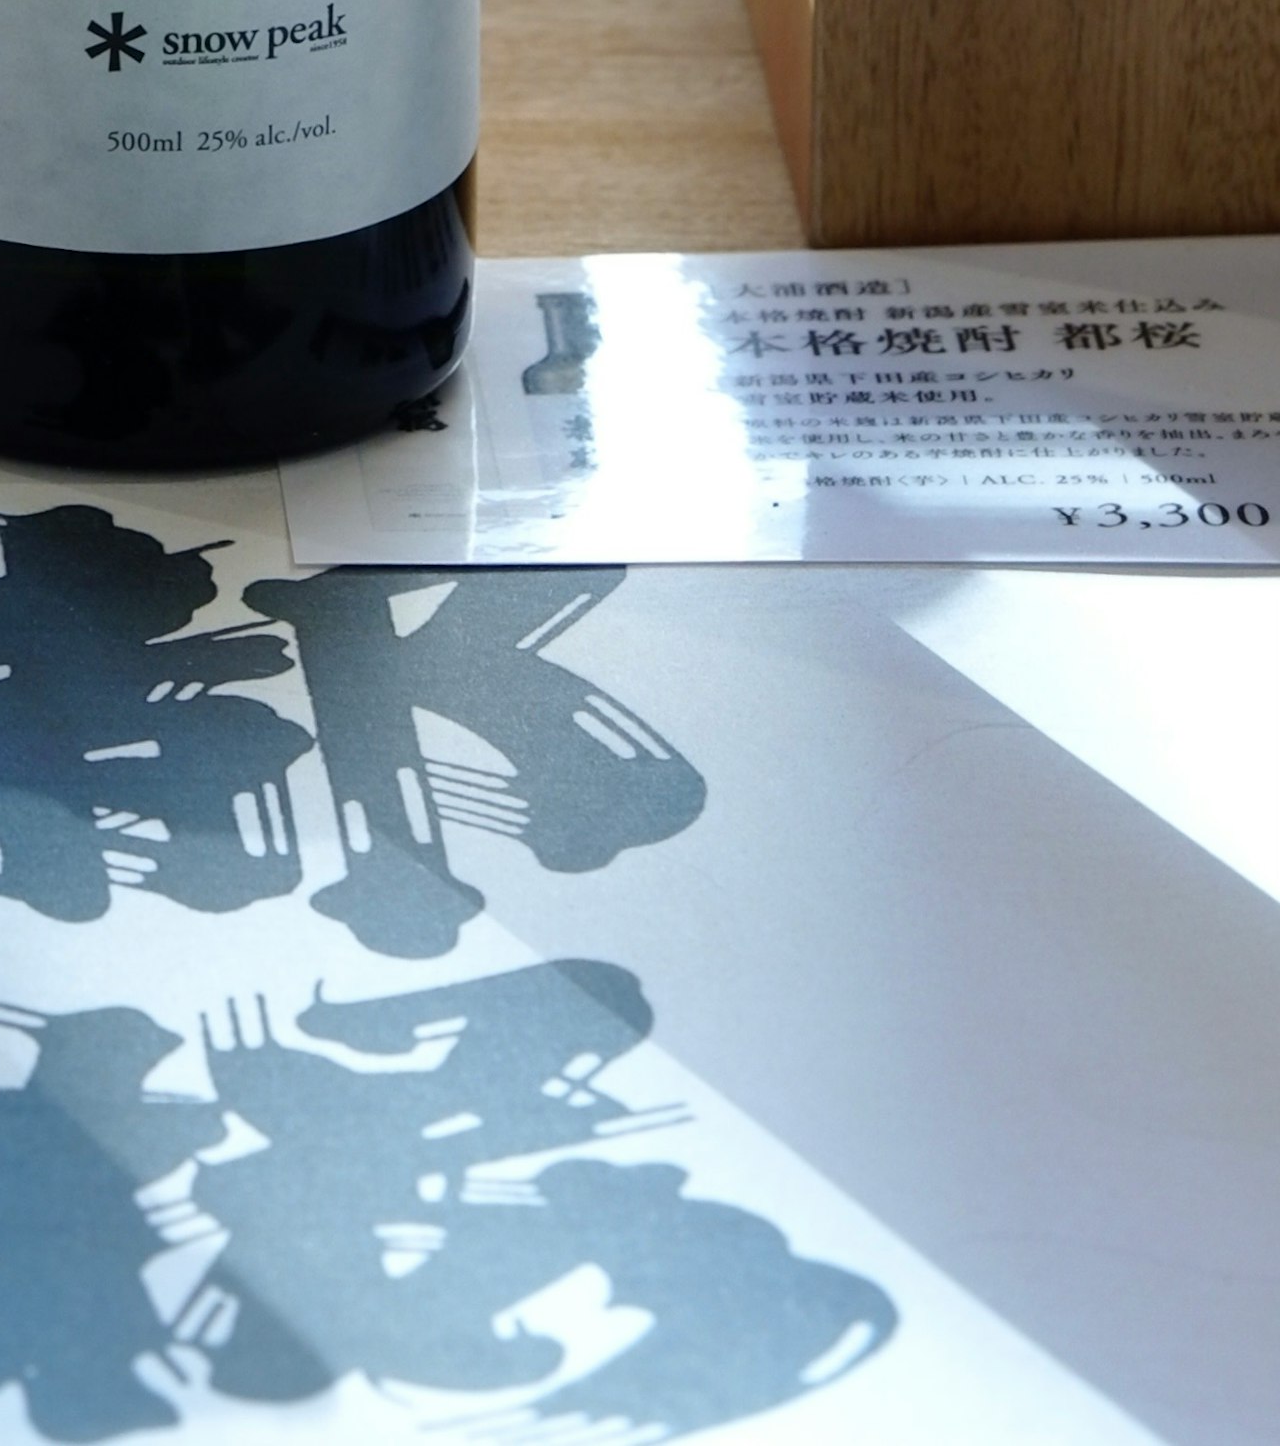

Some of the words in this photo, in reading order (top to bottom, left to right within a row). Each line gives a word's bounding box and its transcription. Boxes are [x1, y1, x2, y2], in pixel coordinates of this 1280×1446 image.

[162, 28, 260, 56] snow
[265, 2, 347, 60] peak
[107, 131, 183, 153] 500ml
[197, 129, 248, 152] 25%
[255, 114, 337, 148] alc./vol.
[886, 297, 1226, 320] 新潟産雪室米仕込み
[728, 324, 1021, 358] 本格焼酎
[1054, 321, 1201, 351] 都桜
[734, 367, 1075, 388] 新潟県下田産コシヒカリ
[981, 474, 1045, 486] ALC.
[1055, 474, 1109, 486] 25%
[1140, 473, 1217, 486] 500ml
